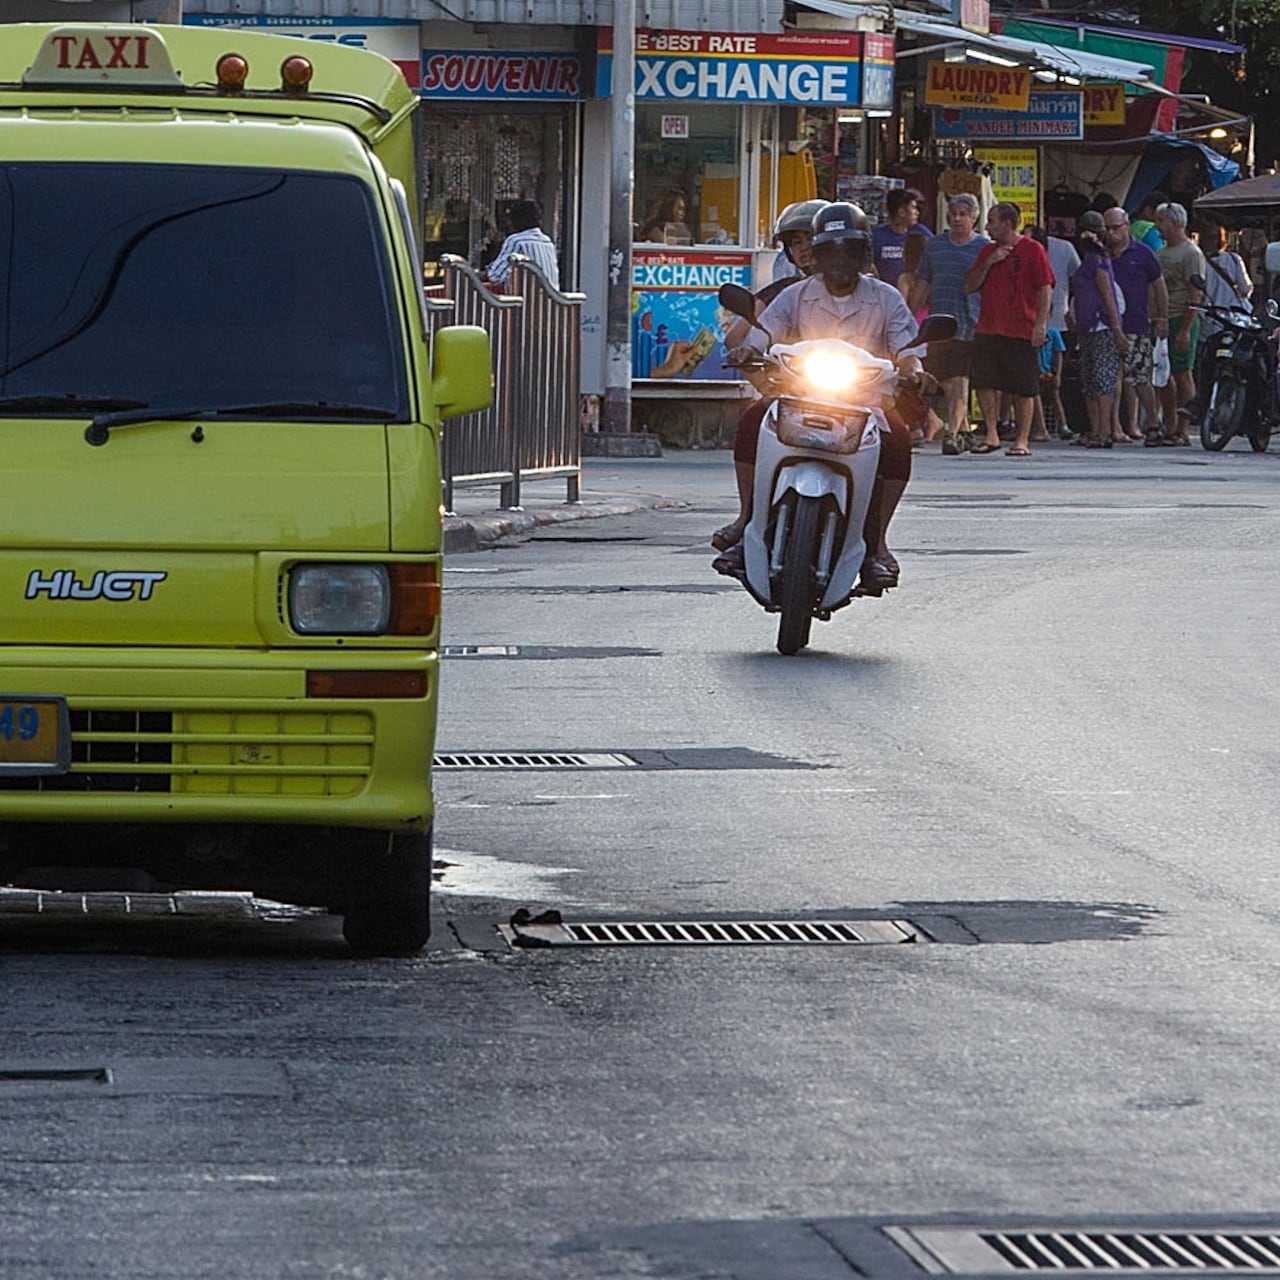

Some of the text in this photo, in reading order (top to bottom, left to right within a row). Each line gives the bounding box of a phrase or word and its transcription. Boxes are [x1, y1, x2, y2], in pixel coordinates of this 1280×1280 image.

[51, 34, 150, 70] TAXI
[708, 37, 757, 54] RATE
[422, 53, 581, 93] SOUVENIR
[610, 58, 849, 102] XCHANGE
[931, 66, 1027, 97] LAUNDRY
[1016, 120, 1077, 135] MINIMART
[631, 265, 745, 287] EXCHANGE
[25, 569, 167, 601] HIJET
